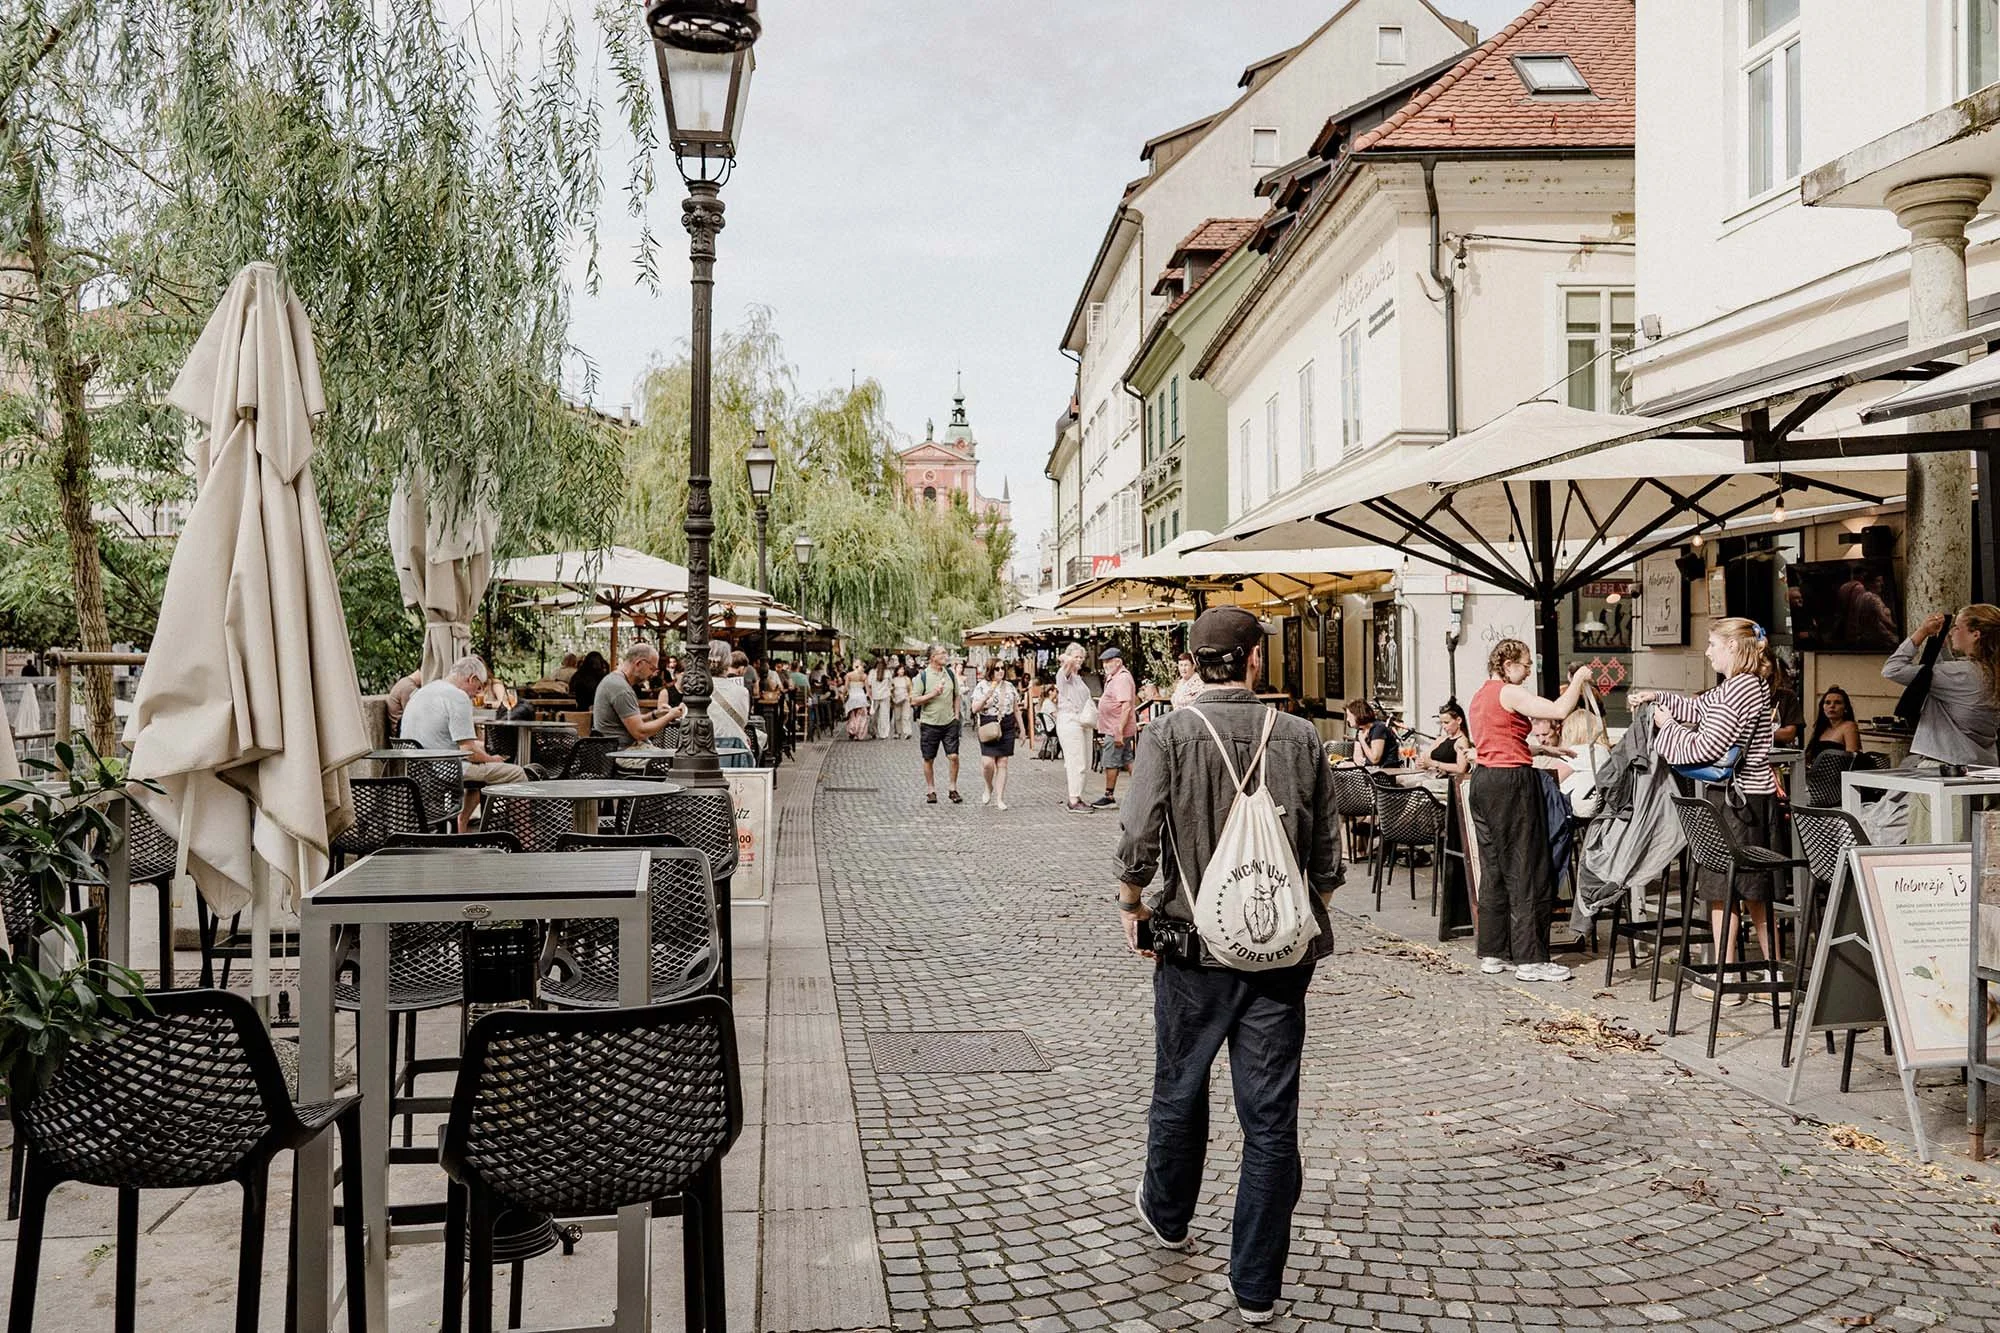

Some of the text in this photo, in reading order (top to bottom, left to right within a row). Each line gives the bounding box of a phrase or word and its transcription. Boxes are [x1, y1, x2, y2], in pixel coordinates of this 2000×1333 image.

[734, 807, 750, 820] itz
[1894, 877, 1944, 896] Nabrežje
[465, 904, 487, 914] vebo
[1228, 942, 1294, 963] FOREVER
